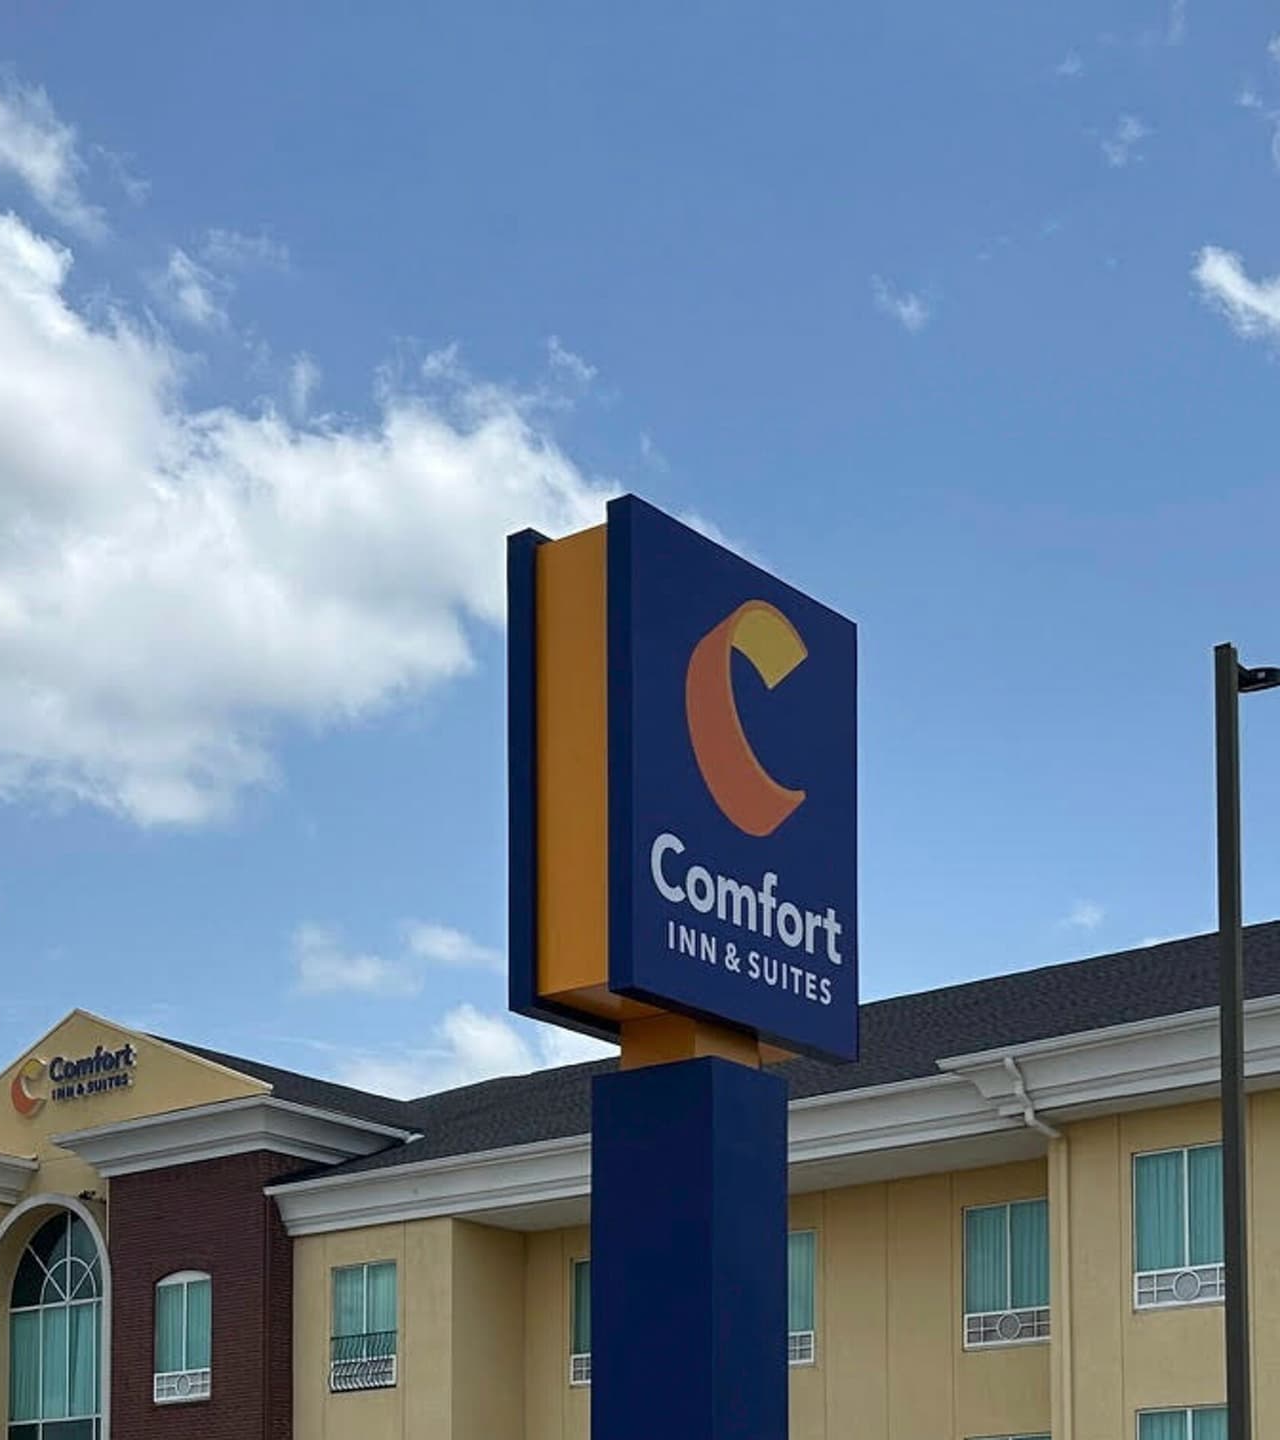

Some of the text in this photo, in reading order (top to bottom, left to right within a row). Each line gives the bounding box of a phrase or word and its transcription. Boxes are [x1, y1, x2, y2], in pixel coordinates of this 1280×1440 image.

[651, 833, 842, 965] Comfort
[668, 921, 832, 1005] INN & SUITES
[49, 1043, 136, 1082] Comfort
[51, 1087, 75, 1100] INN
[86, 1073, 130, 1093] SUITES
